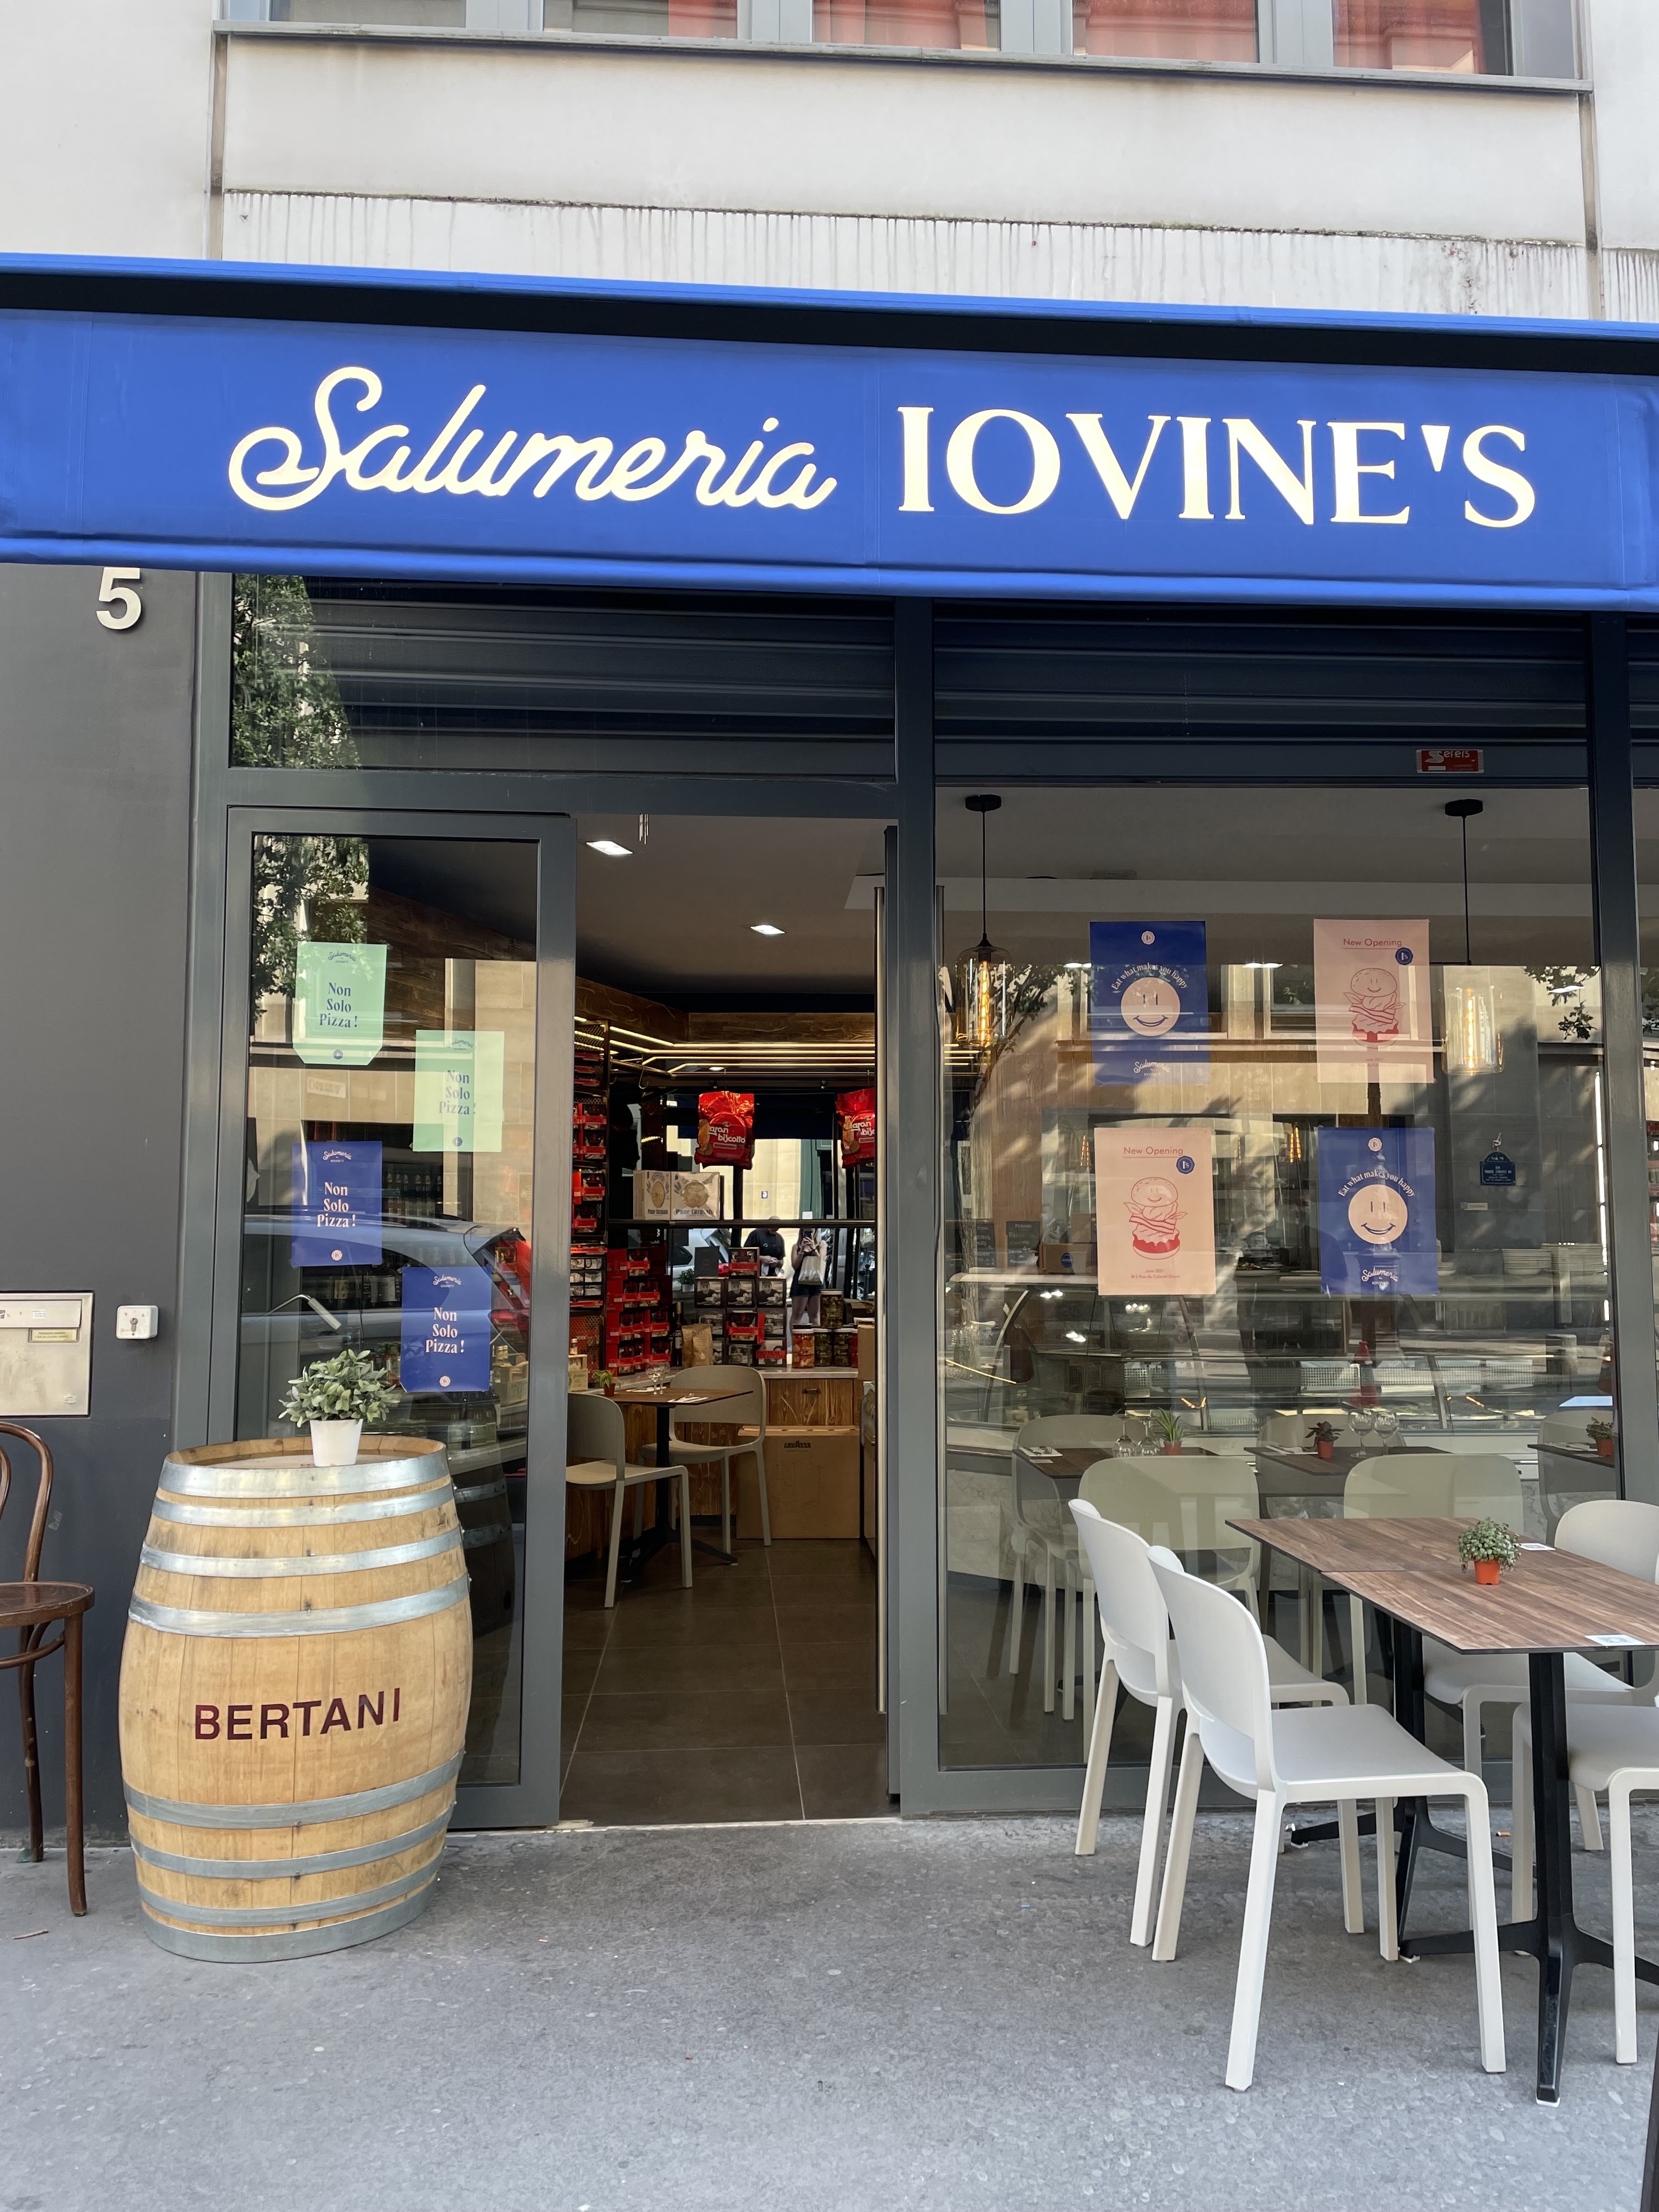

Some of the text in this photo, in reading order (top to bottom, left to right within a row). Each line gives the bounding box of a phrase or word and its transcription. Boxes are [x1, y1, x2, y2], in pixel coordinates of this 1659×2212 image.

[228, 365, 1536, 528] Salumeria IOVINE'S
[96, 567, 142, 630] 5
[1364, 938, 1402, 947] Opening
[1111, 978, 1122, 990] Eat
[1120, 967, 1138, 979] what
[1137, 962, 1159, 971] makes
[1171, 970, 1188, 989] happy
[328, 982, 351, 996] Non
[327, 998, 351, 1013] Solo
[1133, 1059, 1170, 1073] Salumeria
[447, 1070, 469, 1084] Non
[445, 1086, 470, 1100] Solo
[718, 1133, 746, 1143] biscotto
[323, 1149, 351, 1160] Salumeria
[1146, 1147, 1183, 1156] Opening
[324, 1182, 348, 1196] Non
[1338, 1169, 1415, 1197] Eat what makes you happy
[324, 1198, 349, 1212] Solo
[433, 1274, 461, 1285] Salumeria
[1362, 1267, 1398, 1282] Salumeria
[433, 1307, 457, 1321] Non
[432, 1324, 458, 1338] Solo
[195, 1688, 400, 1740] BERTANI
